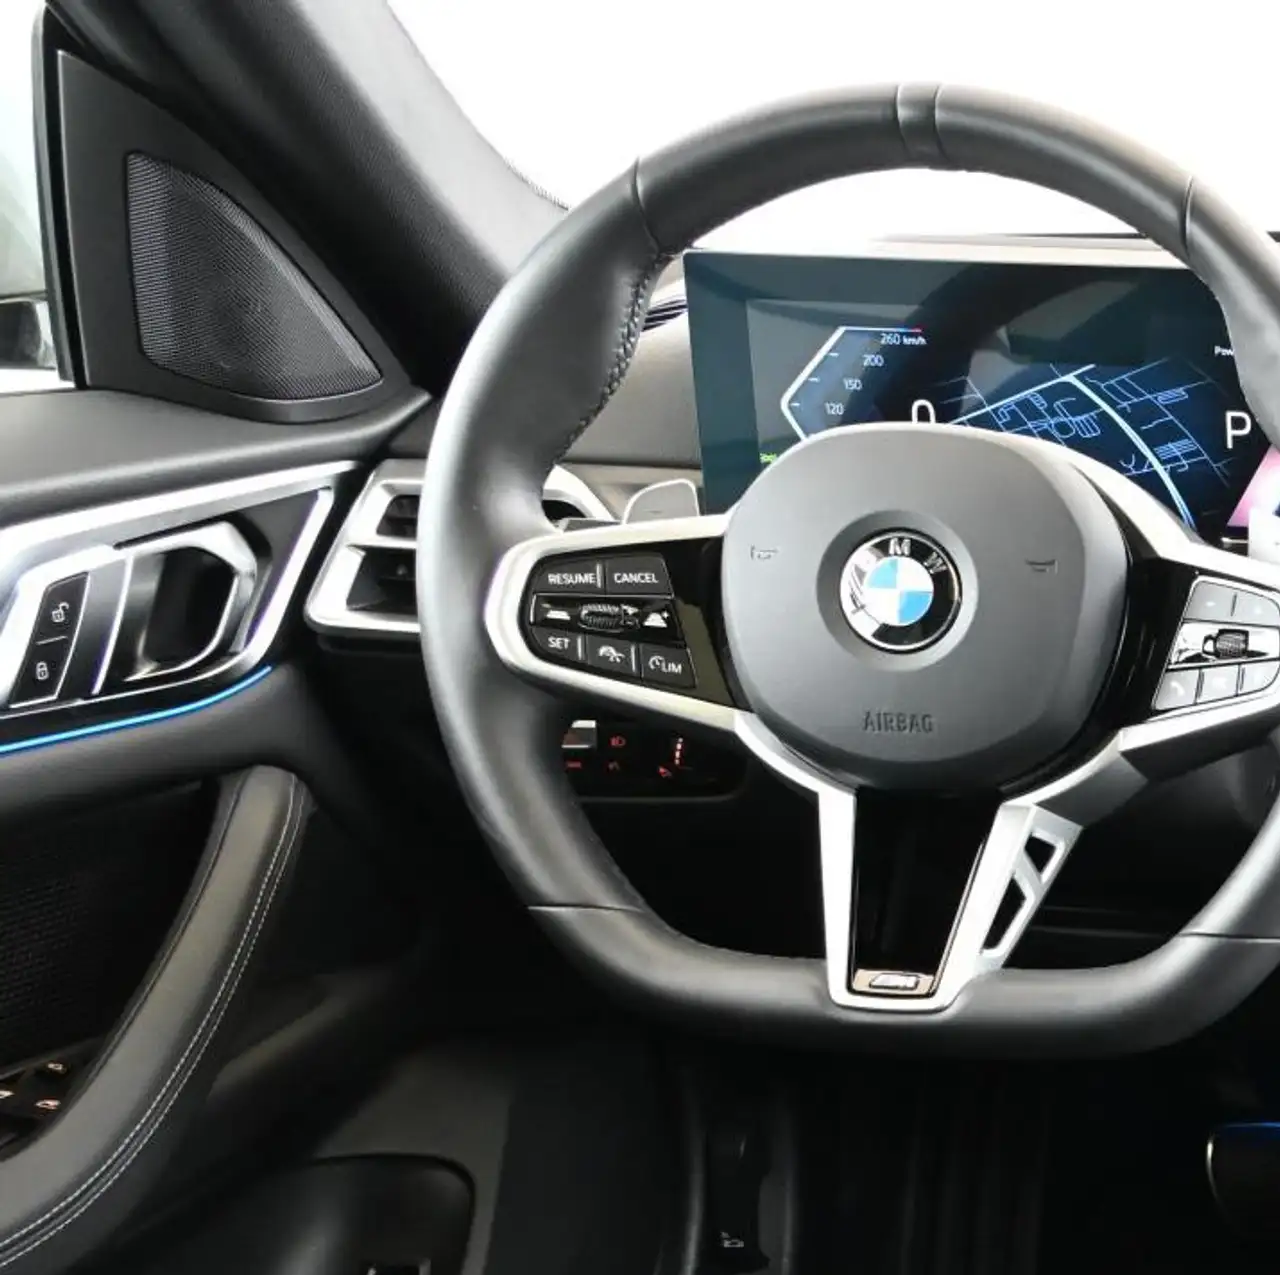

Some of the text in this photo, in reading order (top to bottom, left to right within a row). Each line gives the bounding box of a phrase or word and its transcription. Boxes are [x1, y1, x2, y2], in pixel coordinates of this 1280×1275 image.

[880, 333, 927, 345] 260 km/h
[863, 354, 884, 367] 200
[843, 378, 862, 390] 150
[825, 403, 844, 415] 120
[1225, 410, 1252, 449] P
[548, 573, 596, 585] RESUME
[614, 572, 659, 584] CANCEL
[548, 636, 570, 650] SET
[662, 661, 682, 675] LIM
[862, 711, 934, 734] AIRBAG
